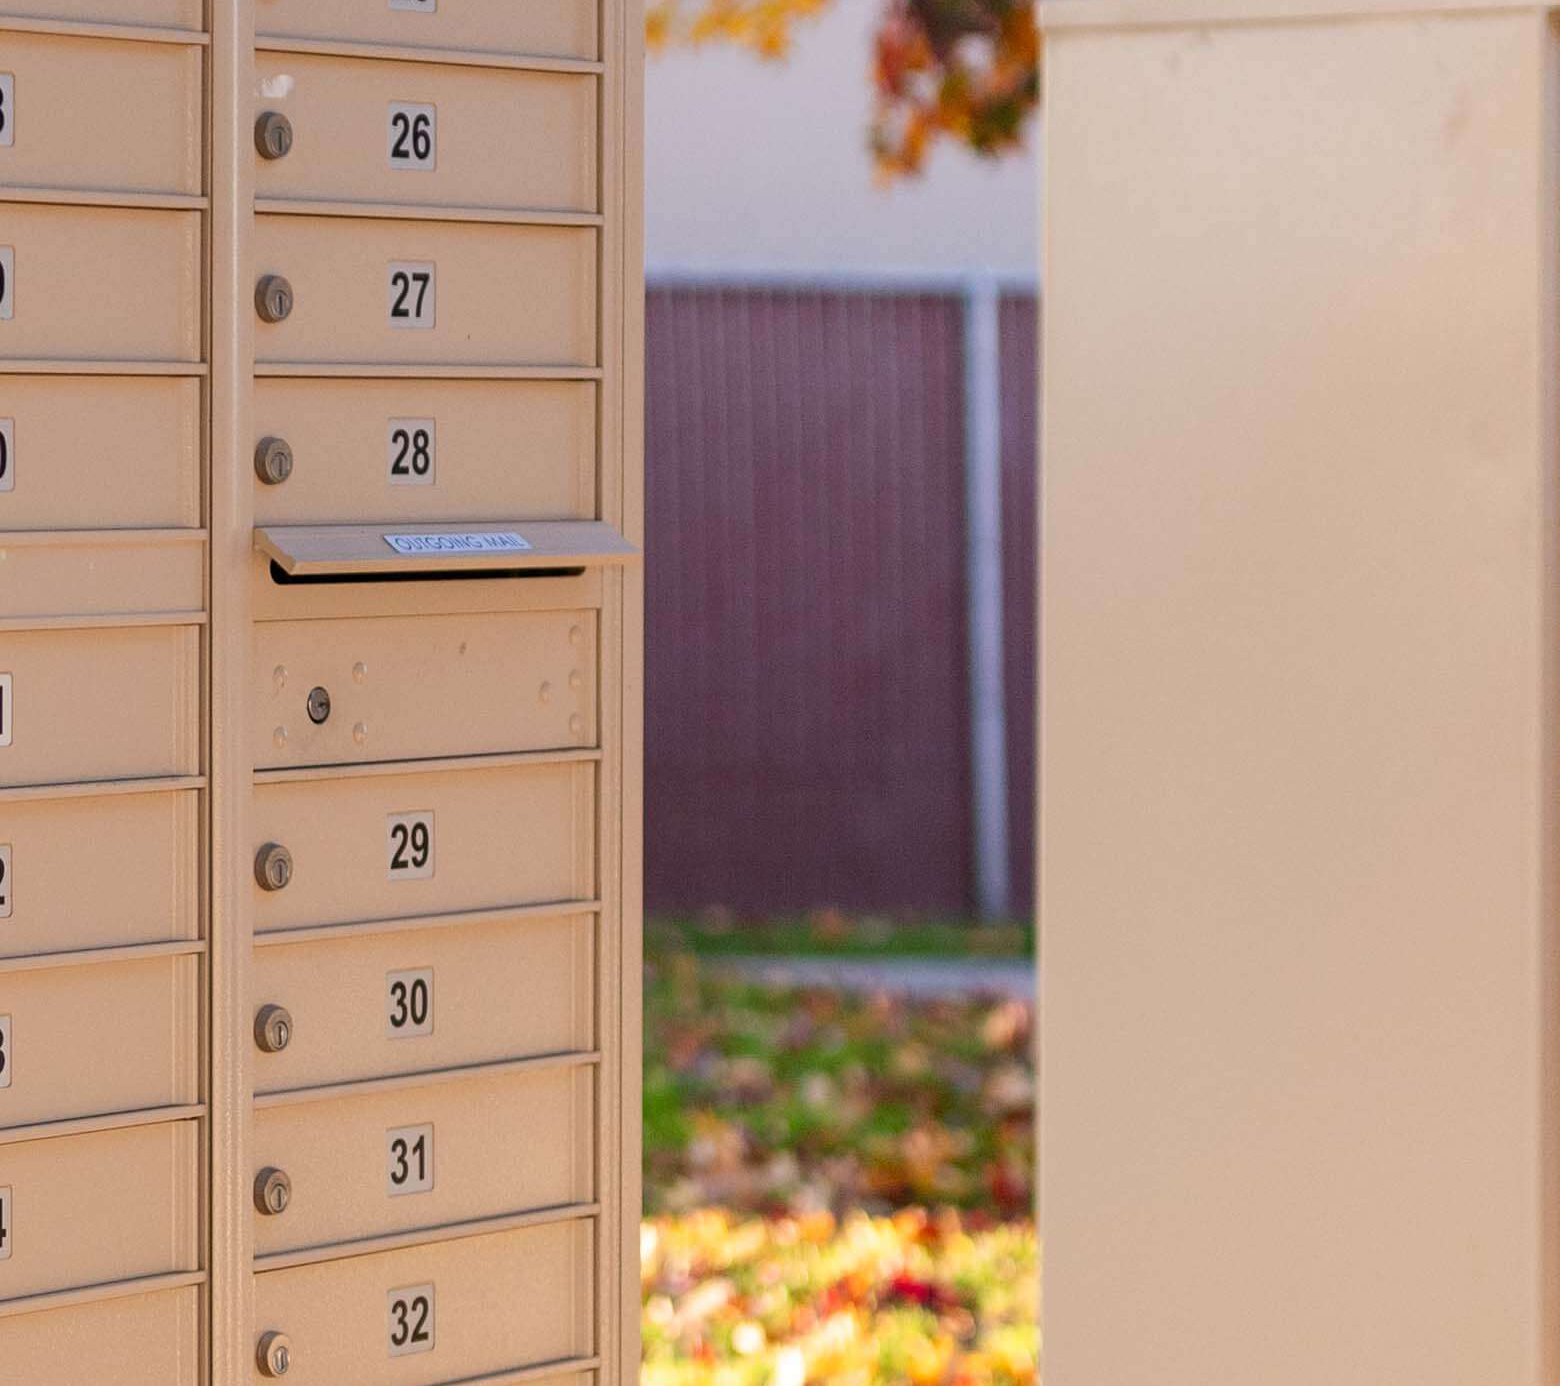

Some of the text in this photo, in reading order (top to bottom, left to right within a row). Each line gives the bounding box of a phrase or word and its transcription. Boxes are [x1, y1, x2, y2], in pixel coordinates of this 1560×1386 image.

[391, 112, 431, 160] 26
[391, 271, 430, 318] 27
[391, 429, 430, 476] 28
[394, 532, 528, 551] OUTGOING MAIL
[390, 822, 429, 870] 29
[390, 978, 428, 1028] 30
[390, 1135, 425, 1185] 31
[391, 1295, 429, 1346] 32
